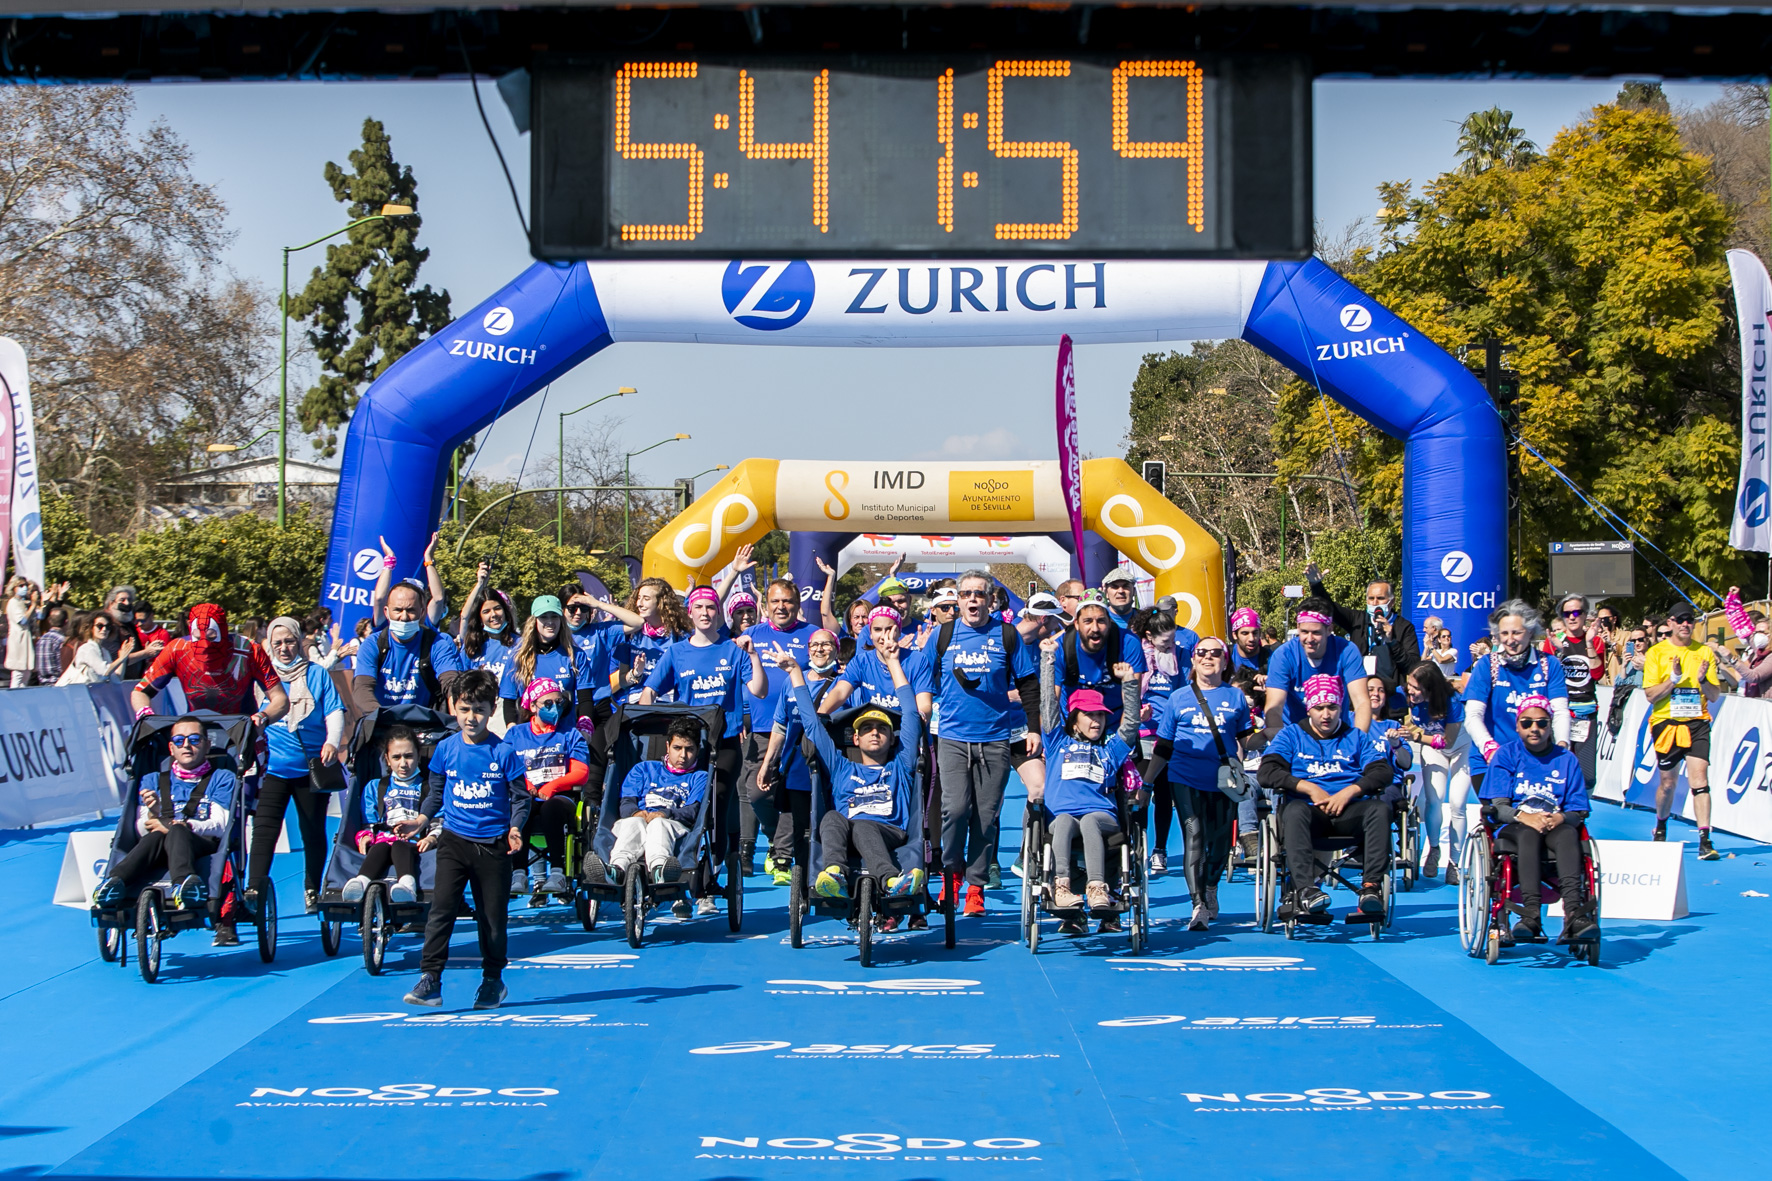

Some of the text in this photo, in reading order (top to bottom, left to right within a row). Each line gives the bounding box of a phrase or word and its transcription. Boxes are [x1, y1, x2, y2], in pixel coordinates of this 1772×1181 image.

[846, 263, 1107, 315] ZURICH
[449, 340, 537, 365] ZURICH
[1317, 337, 1406, 361] ZURICH
[873, 470, 925, 490] IMD
[861, 504, 936, 513] Instituto Municipal
[971, 503, 1012, 511] DE SEVILLA
[874, 513, 925, 523] de Deportes
[328, 583, 376, 607] ZURI
[1417, 591, 1496, 609] ZURICH
[399, 789, 421, 797] ZURIC
[1599, 872, 1661, 886] ZURICH
[404, 1013, 598, 1023] asics
[1191, 1016, 1377, 1026] asics
[791, 1043, 997, 1055] asics
[1193, 1105, 1373, 1113] AYUNTAMIENTO
[695, 1153, 896, 1161] AYUNTAMIENTO
